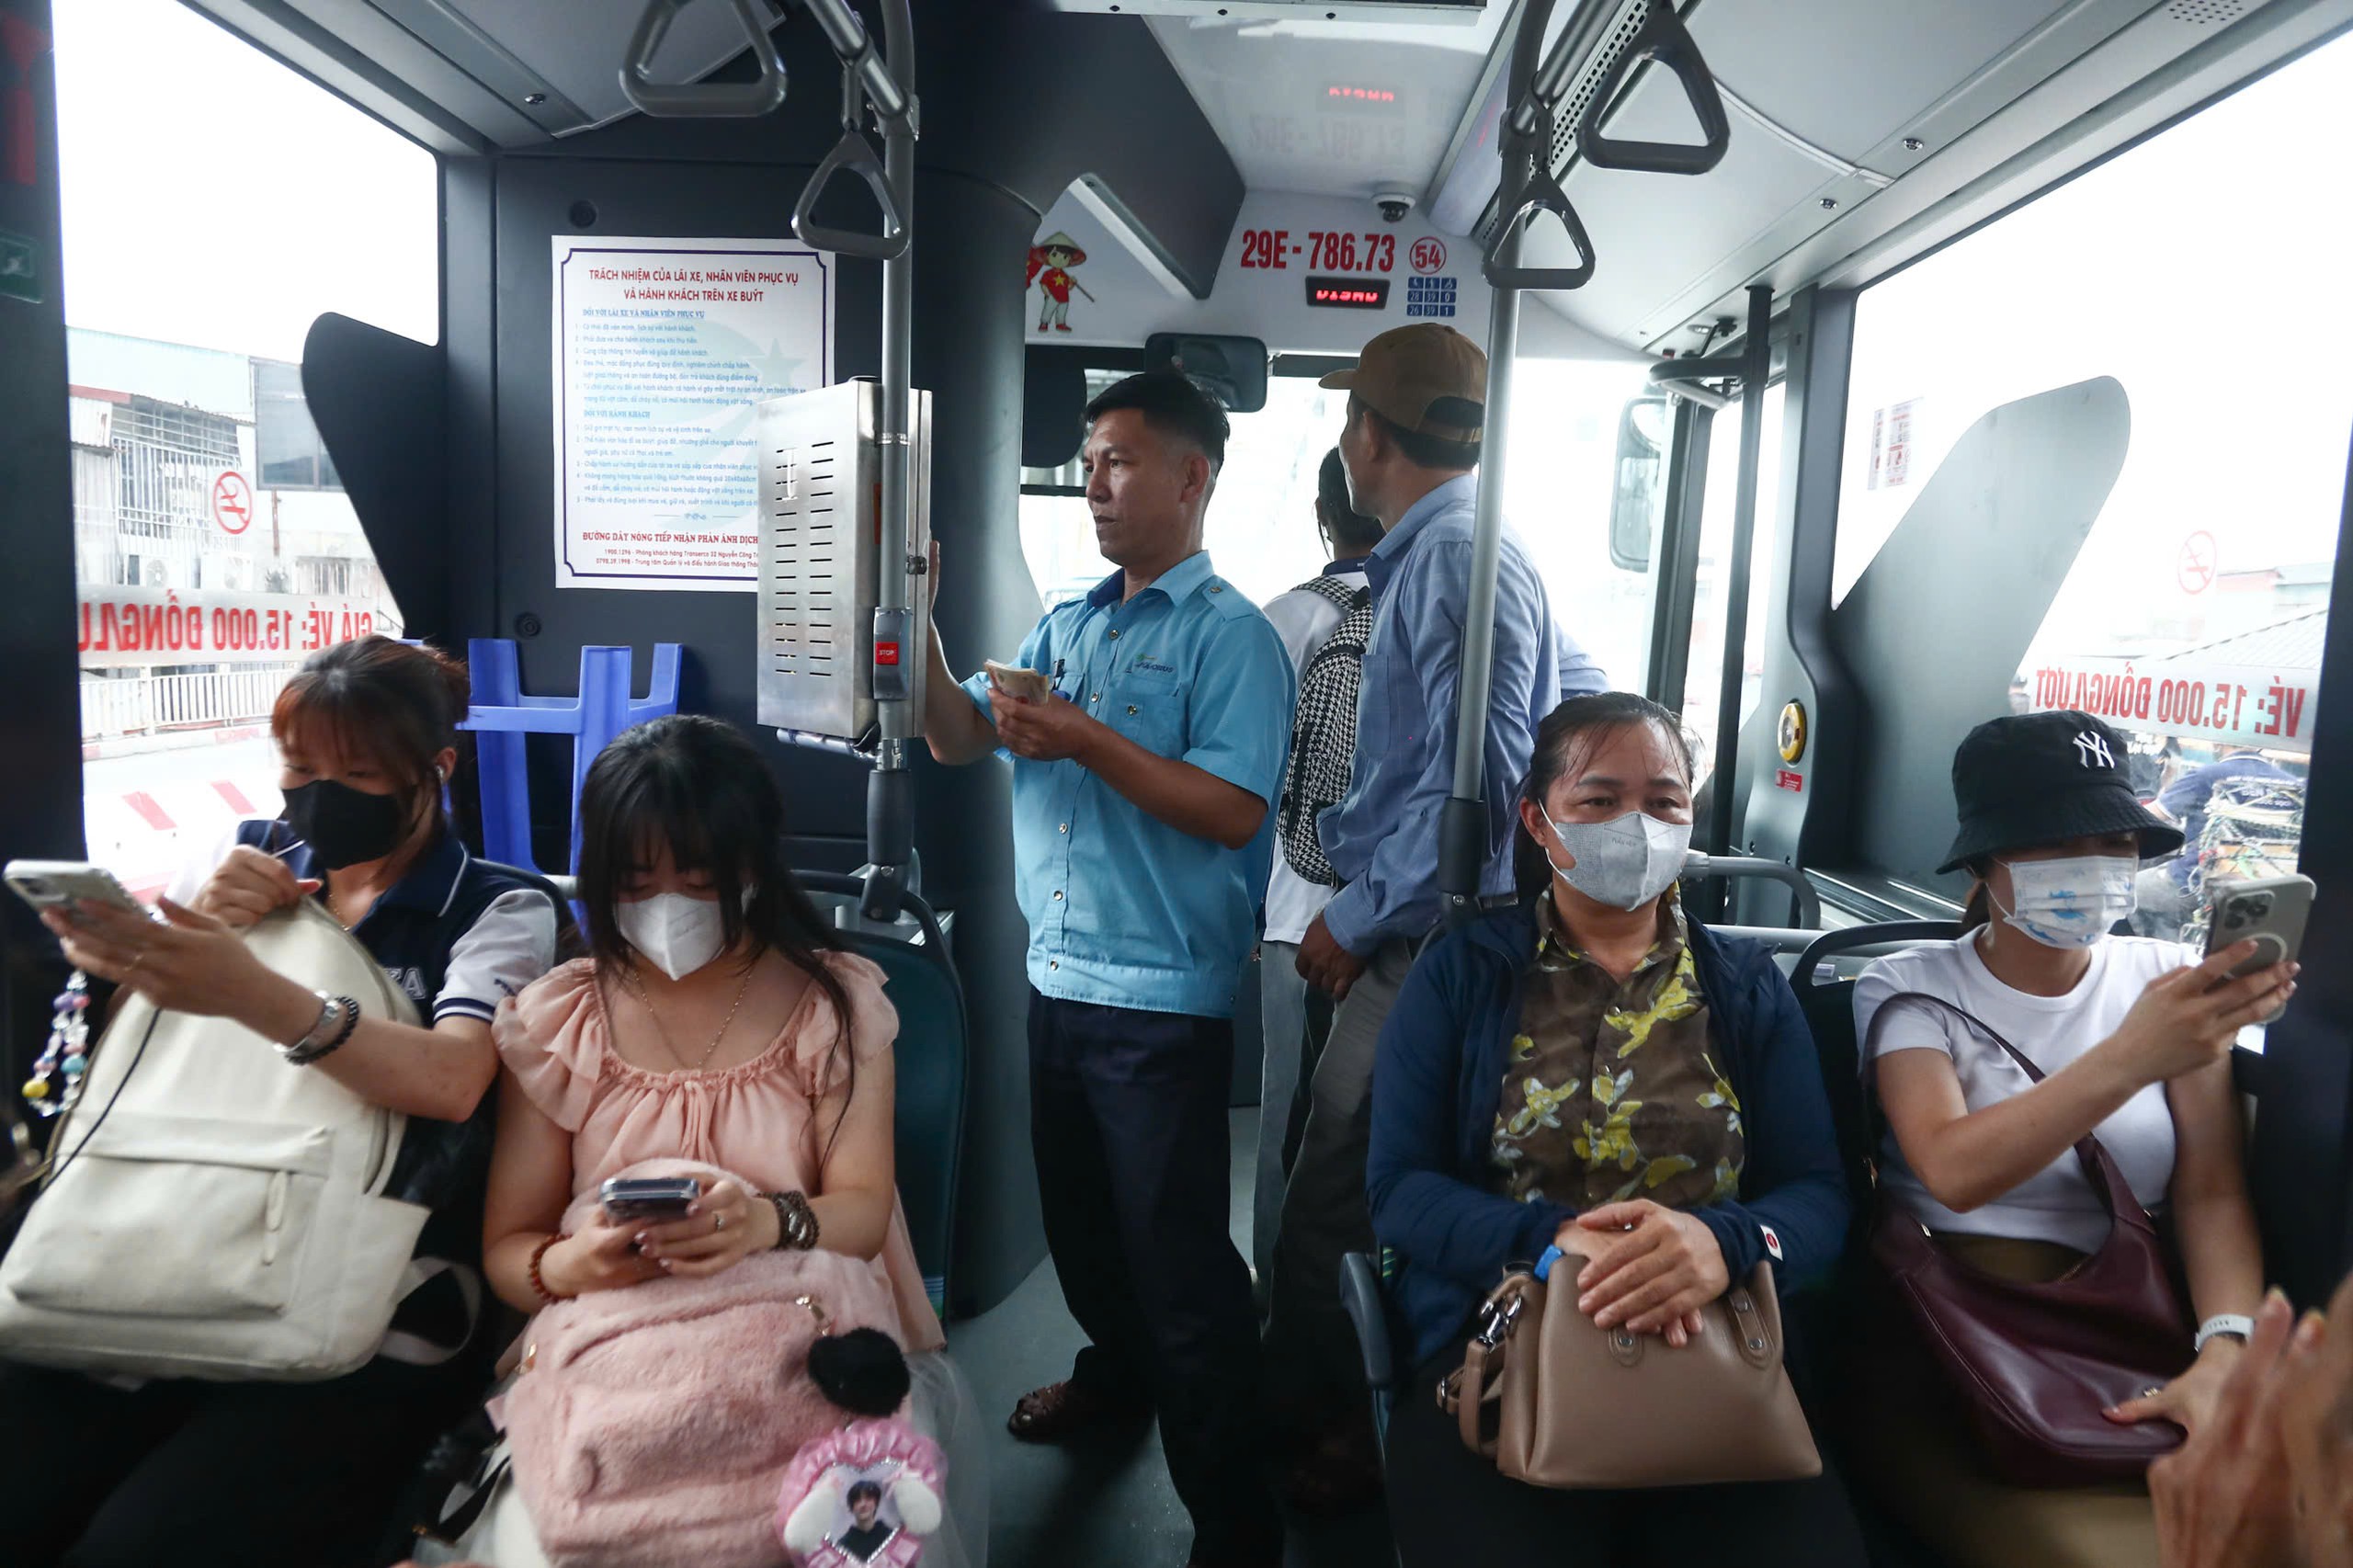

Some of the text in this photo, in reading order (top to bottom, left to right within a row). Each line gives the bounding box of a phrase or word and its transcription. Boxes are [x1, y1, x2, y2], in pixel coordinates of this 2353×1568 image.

[1415, 244, 1441, 268] 54
[589, 267, 619, 280] TRÁCH
[620, 267, 651, 284] NHIỆM
[652, 267, 672, 281] CỦA
[690, 272, 704, 284] XE,
[706, 269, 733, 282] NHÂN
[735, 269, 756, 283] VIÊN
[758, 273, 783, 286] PHỤC
[786, 273, 800, 286] VỤ
[623, 288, 765, 302] VÀ HÀNH KHÁCH TRÊN XE BUÝT
[583, 530, 610, 541] ĐƯỜNG
[654, 530, 672, 542] TIẾP
[2072, 729, 2117, 770] NY
